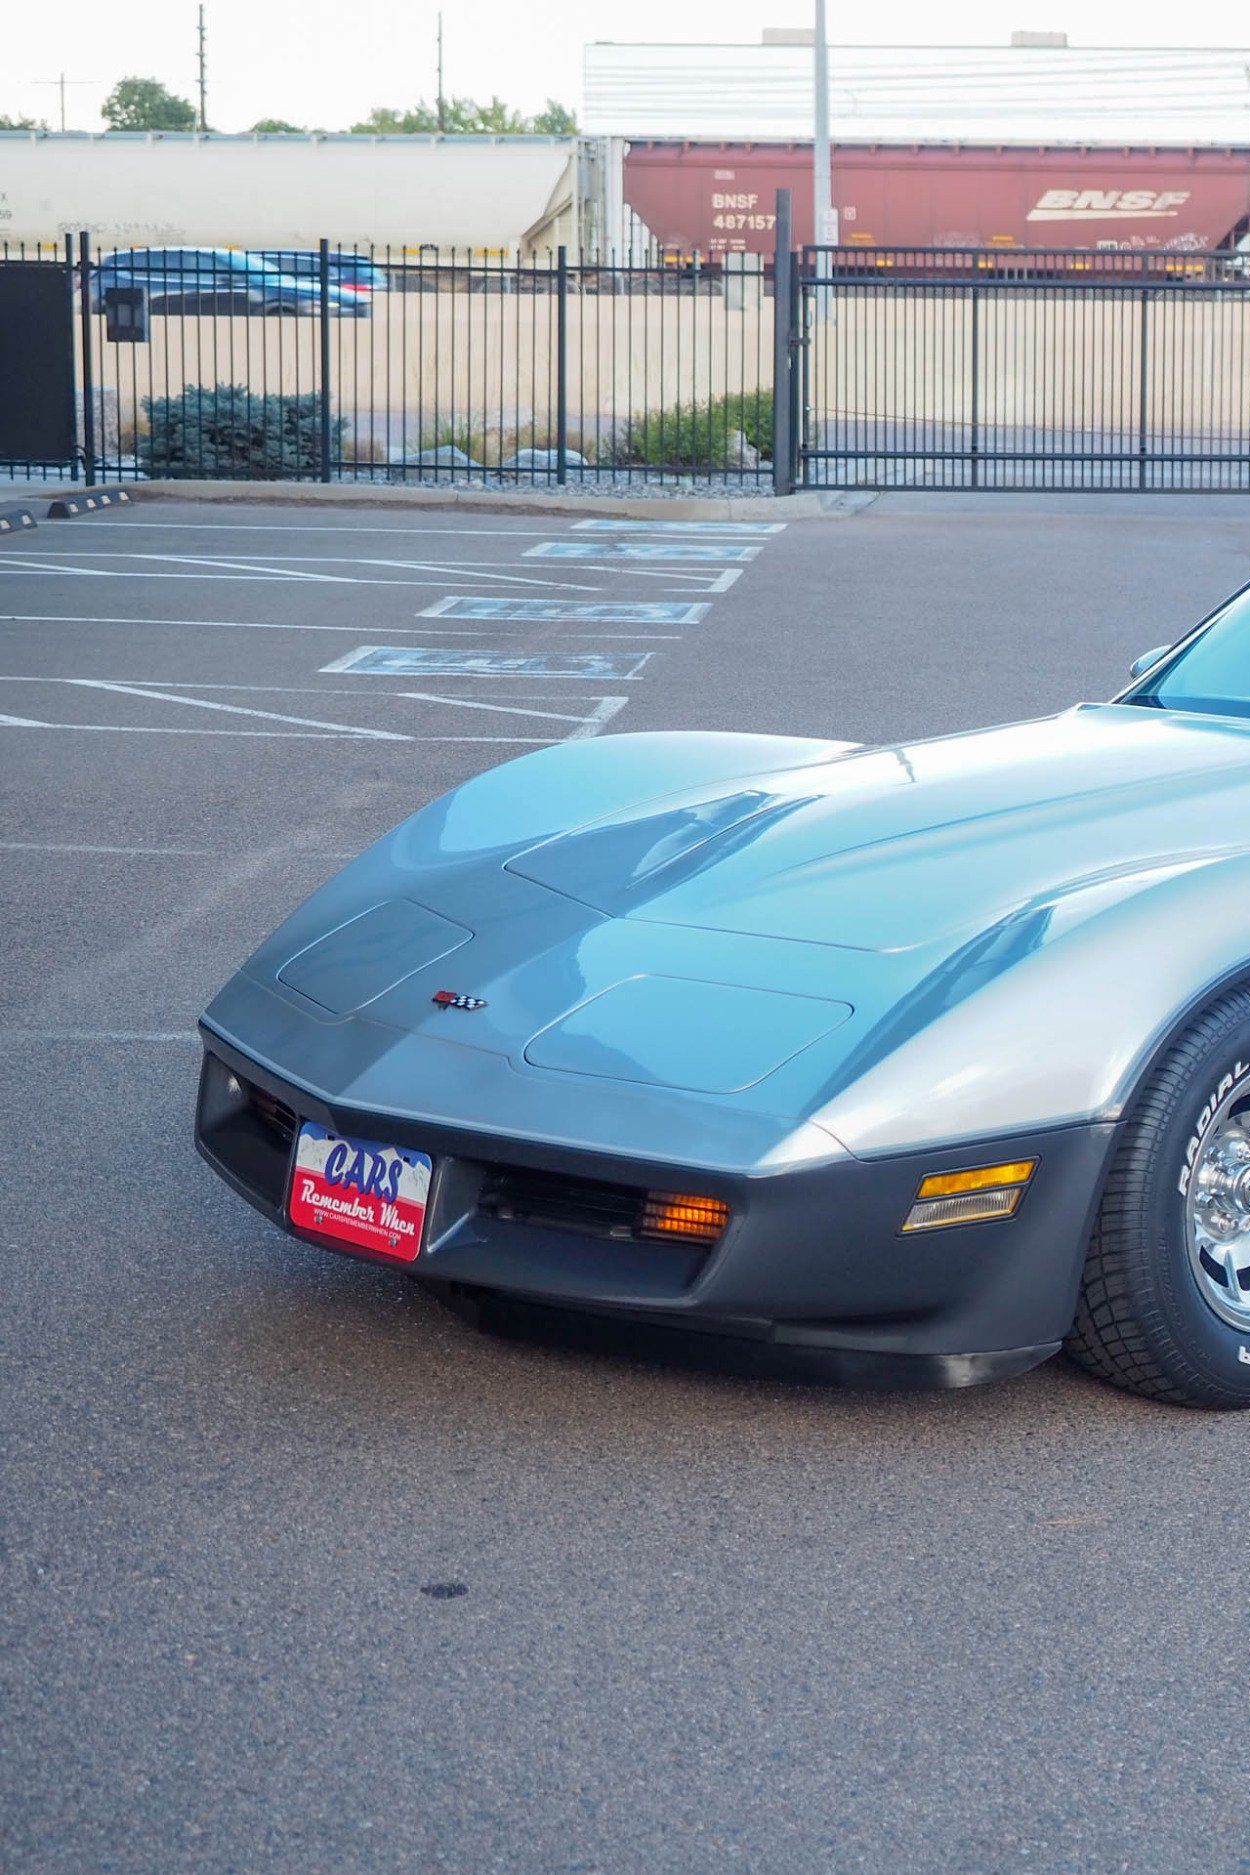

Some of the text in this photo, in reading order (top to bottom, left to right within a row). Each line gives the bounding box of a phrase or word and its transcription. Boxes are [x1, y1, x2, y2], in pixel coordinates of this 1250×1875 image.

[712, 193, 758, 209] BNSF
[1036, 190, 1191, 210] BNSF
[713, 214, 777, 230] 487157
[1178, 1061, 1250, 1196] RADIAL
[325, 1143, 403, 1204] CARS
[301, 1179, 415, 1236] Remember When
